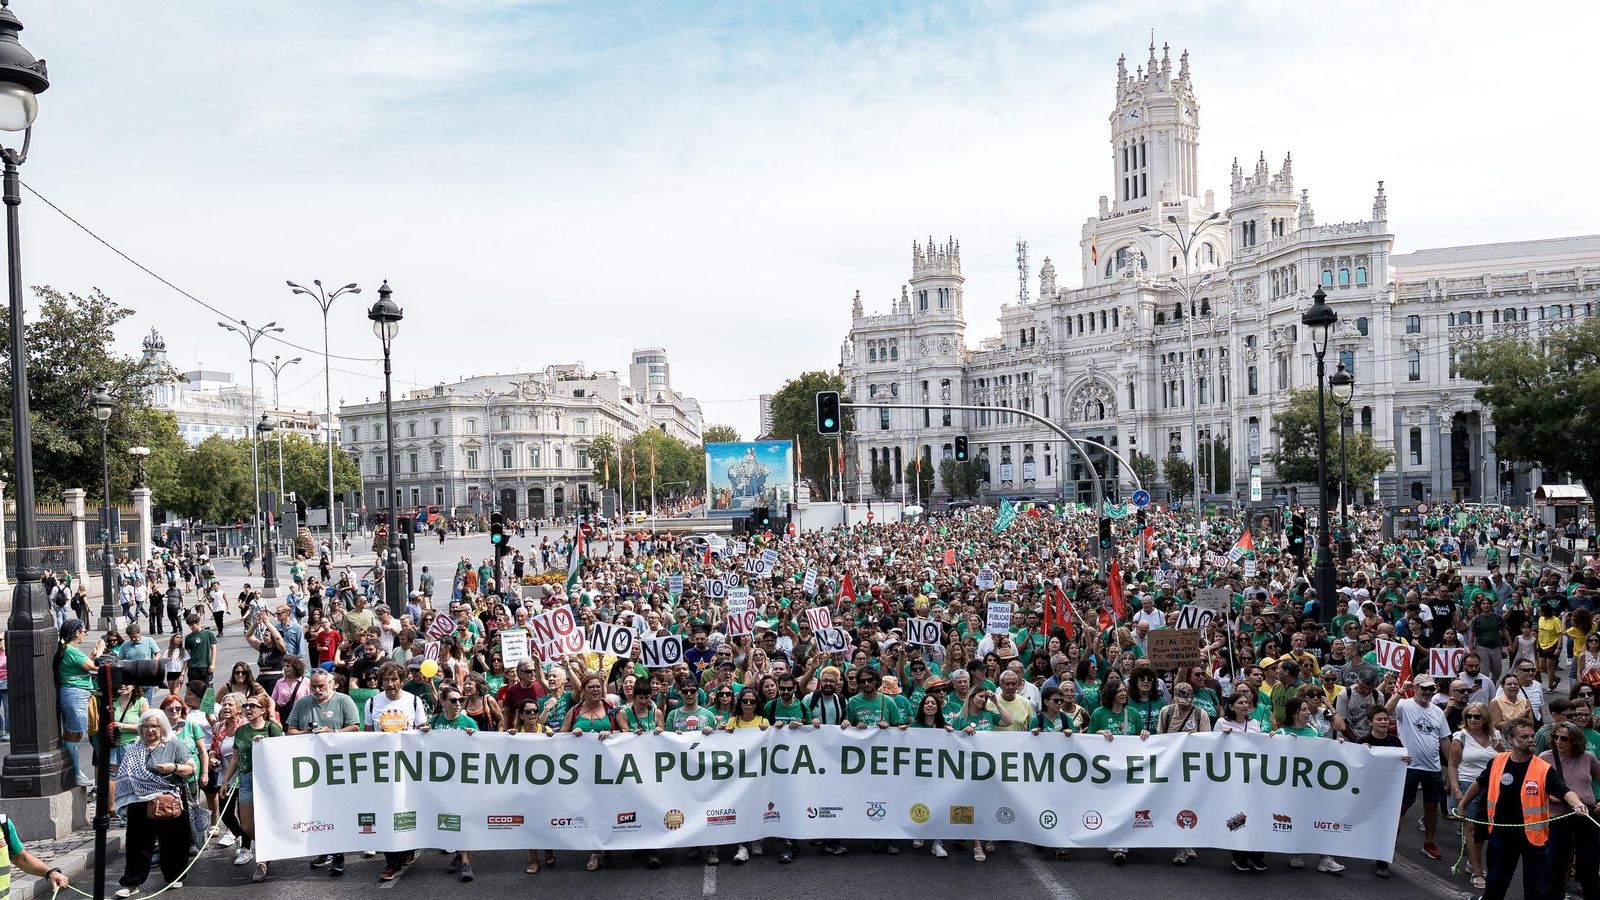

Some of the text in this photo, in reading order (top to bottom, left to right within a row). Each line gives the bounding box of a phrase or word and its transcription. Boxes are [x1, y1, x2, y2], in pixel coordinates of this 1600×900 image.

[720, 547, 733, 556] NO
[1213, 556, 1225, 566] NO
[745, 559, 765, 573] NO
[723, 573, 739, 587] NO
[428, 614, 455, 640] NO
[532, 608, 574, 645] NO
[728, 611, 757, 635] NO
[807, 608, 830, 631] NO
[1177, 607, 1213, 629] NO
[592, 624, 632, 655] NO
[815, 628, 845, 652] NO
[909, 620, 939, 645] NO
[640, 637, 681, 665] NO
[1377, 640, 1411, 671] NO
[1431, 649, 1465, 675] NO
[292, 742, 1360, 795] DEFENDEMOS LA PÚBLICA. DEFENDEMOS EL FUTURO.
[550, 818, 573, 826] CGT
[620, 814, 634, 822] CNT
[706, 808, 736, 816] CONFAPA
[1273, 822, 1292, 830] STEM
[1314, 821, 1332, 829] UGT
